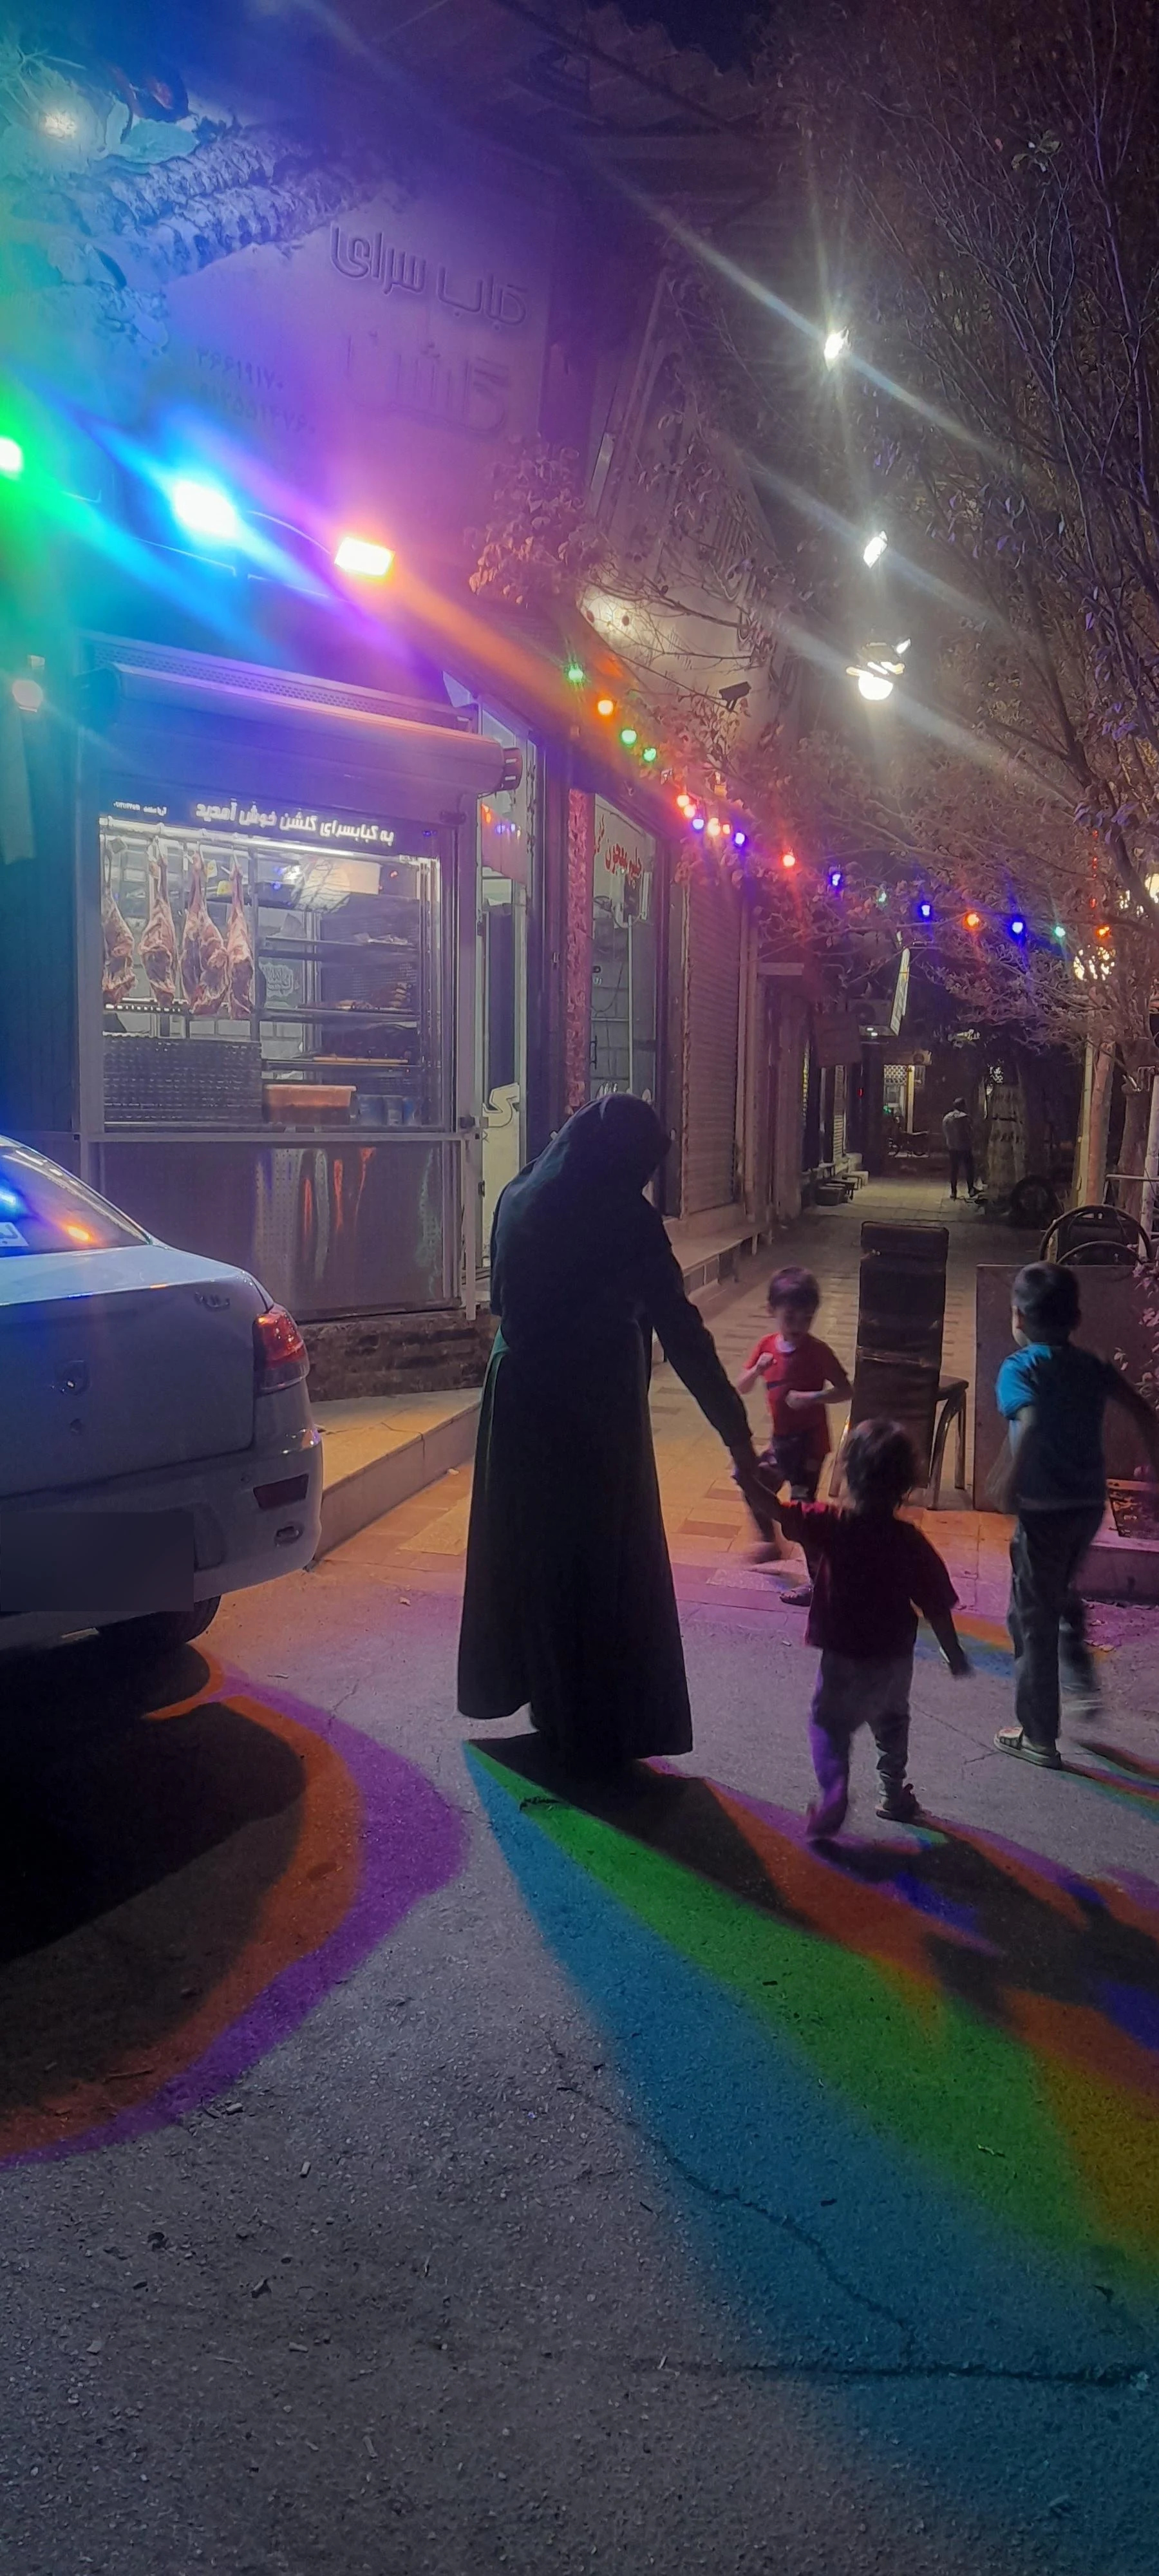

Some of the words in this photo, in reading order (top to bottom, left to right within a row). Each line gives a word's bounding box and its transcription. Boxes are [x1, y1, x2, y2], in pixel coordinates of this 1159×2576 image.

[330, 222, 427, 296] سرای
[345, 330, 510, 435] گلشن
[196, 797, 237, 822] آمدید
[239, 800, 277, 828] خوش
[279, 808, 319, 832] گلشن
[380, 830, 395, 846] به
